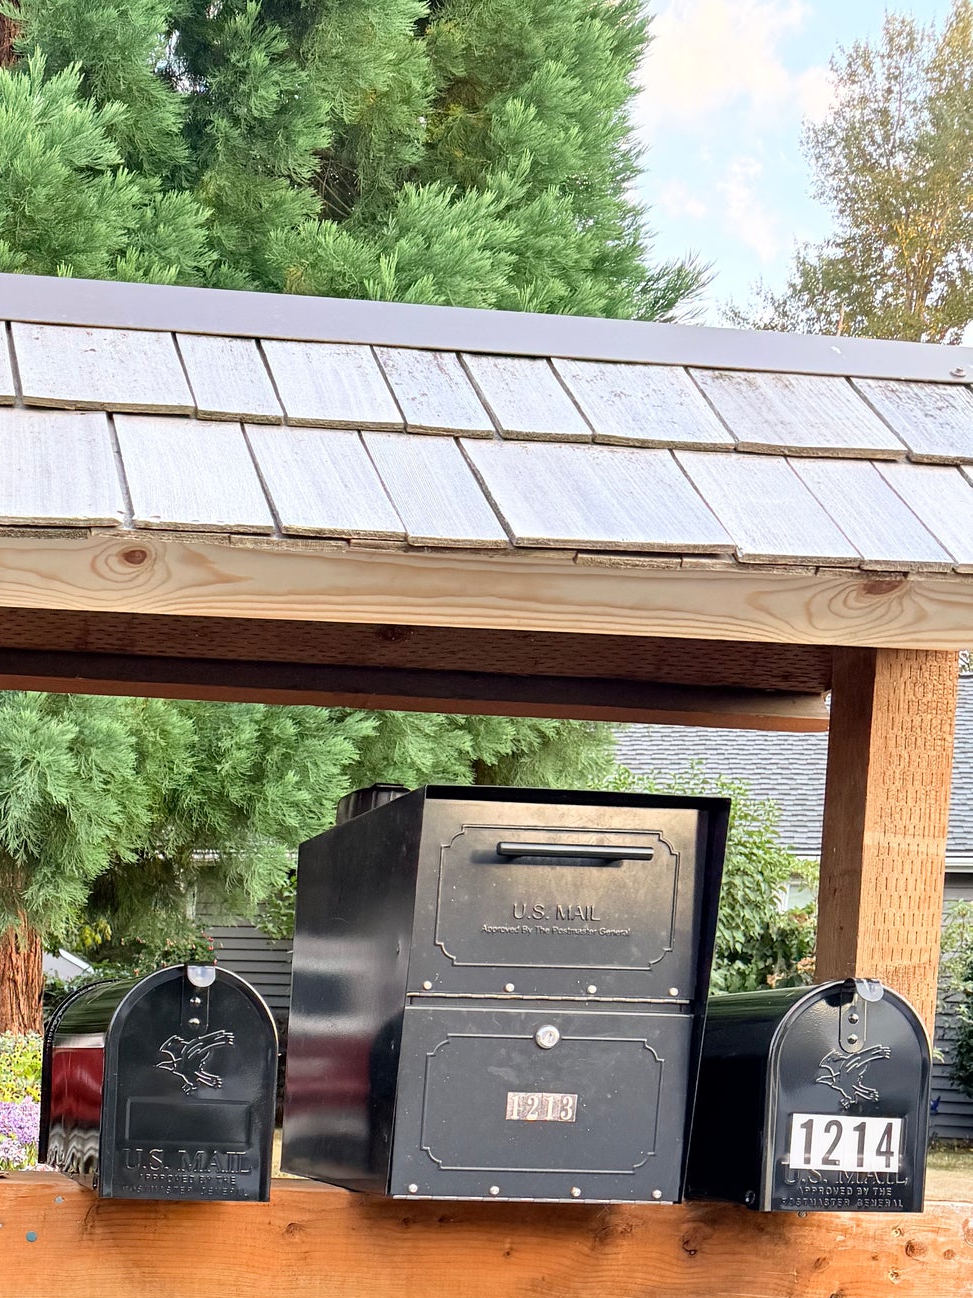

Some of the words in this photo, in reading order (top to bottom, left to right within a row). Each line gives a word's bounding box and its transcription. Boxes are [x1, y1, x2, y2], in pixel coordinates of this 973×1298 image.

[512, 902, 549, 920] U.S.
[555, 904, 601, 921] MAIL
[481, 923, 519, 935] Approved
[521, 925, 532, 936] By
[534, 925, 550, 936] The
[552, 925, 597, 938] Postmaster
[598, 926, 631, 938] General
[510, 1095, 574, 1121] 1213
[799, 1118, 895, 1169] 1214
[123, 1148, 170, 1171] U.S.
[177, 1150, 253, 1174] MAIL
[799, 1186, 854, 1196] APPROVED
[872, 1187, 893, 1197] THE
